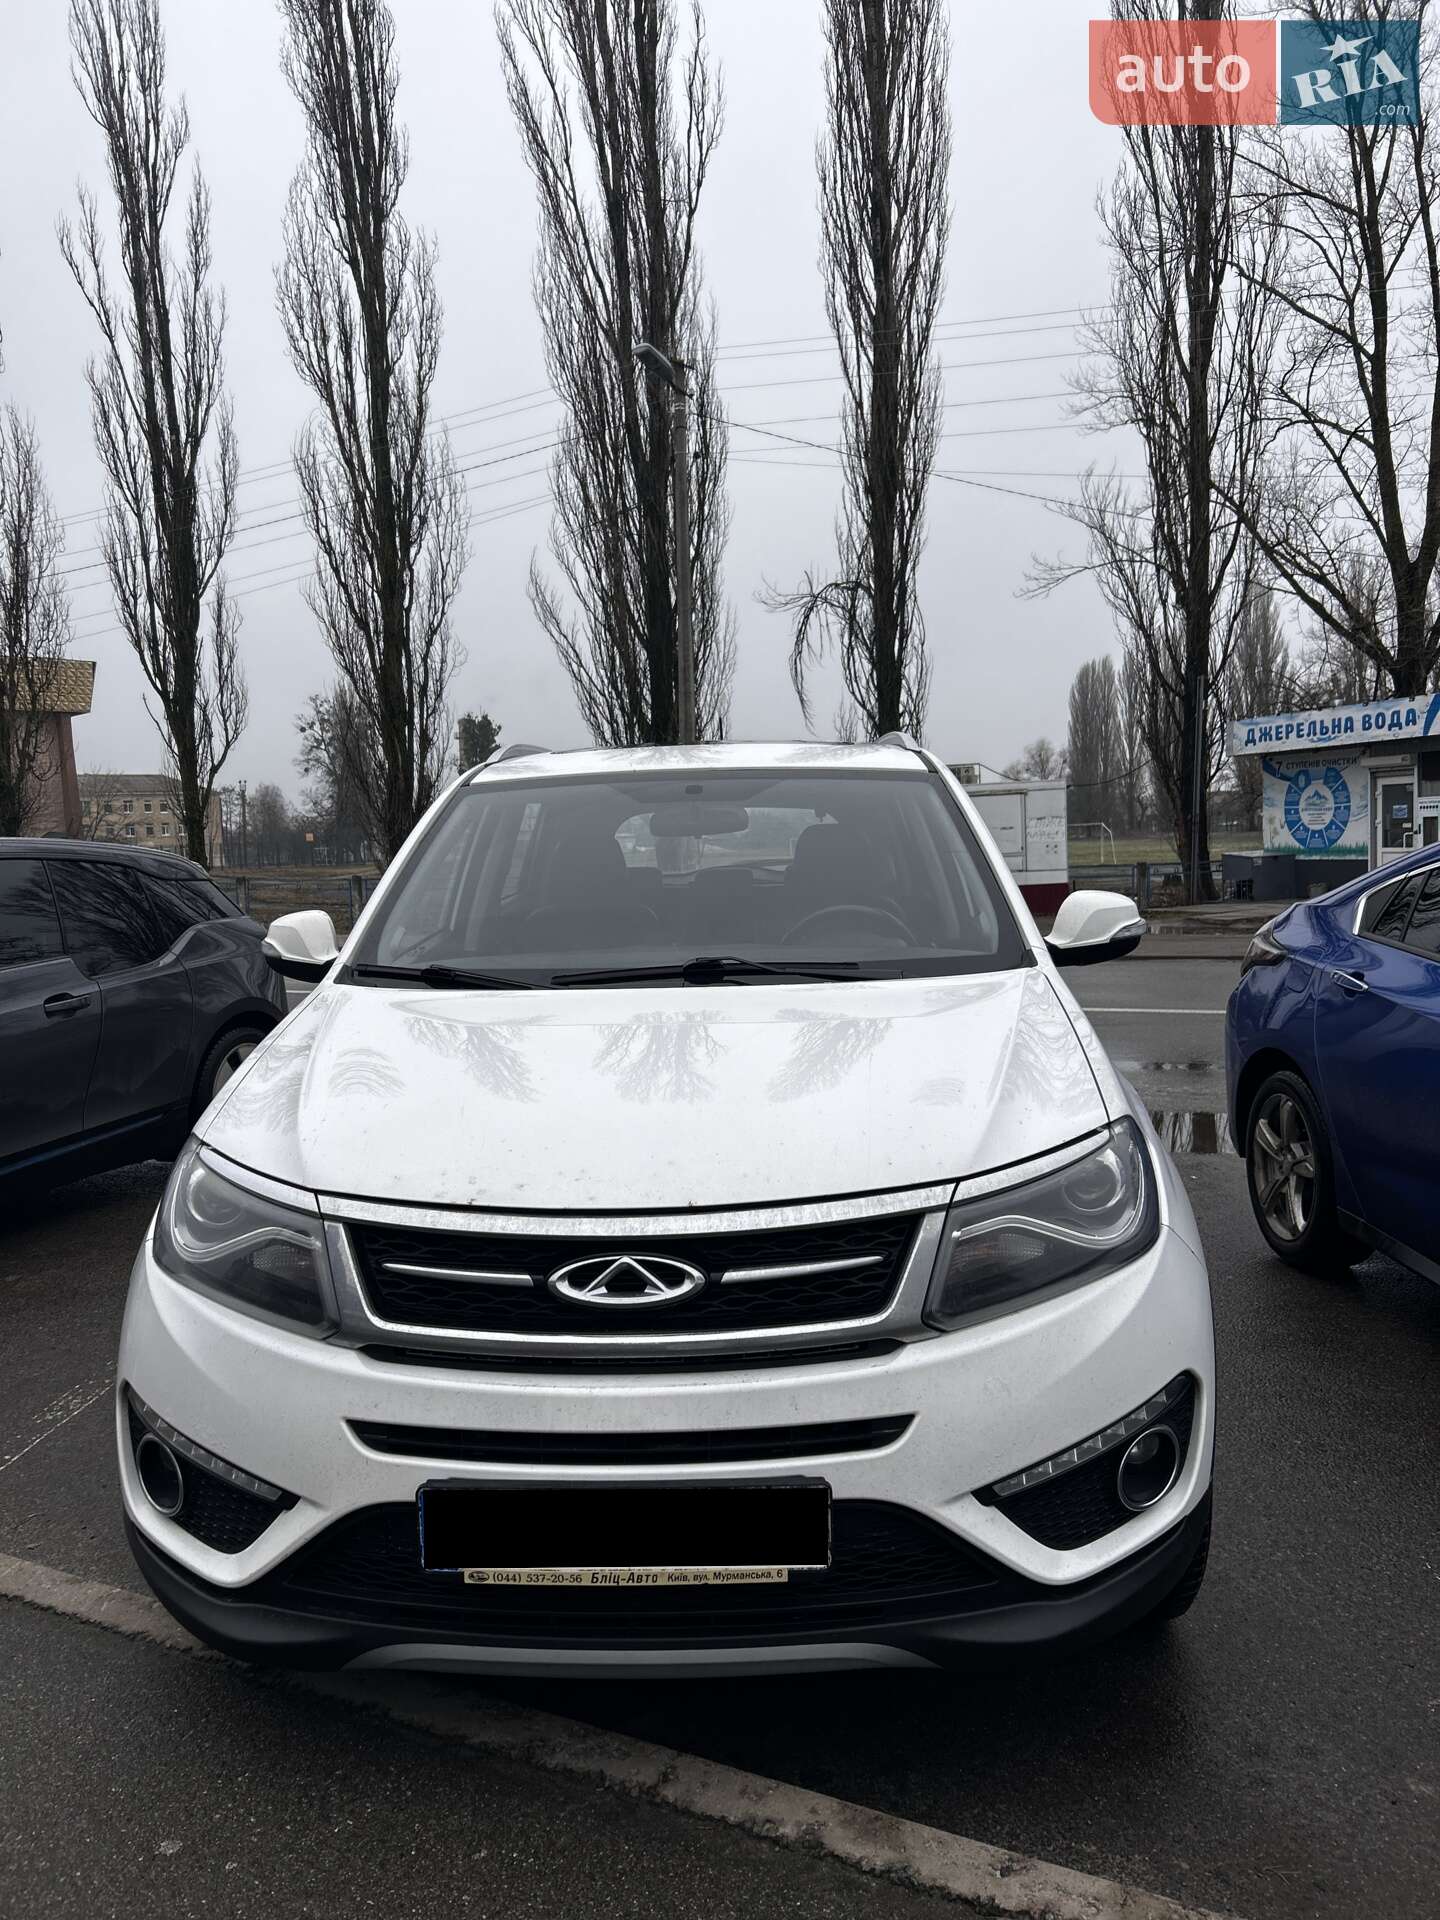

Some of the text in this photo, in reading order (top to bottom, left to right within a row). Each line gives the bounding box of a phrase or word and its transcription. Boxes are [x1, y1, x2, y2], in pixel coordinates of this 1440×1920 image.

[1244, 708, 1417, 747] ДЖЕРЕЛЬНА ВОДА
[492, 1572, 522, 1583] (044)
[526, 1573, 582, 1583] 537-20-56
[590, 1572, 658, 1585] Бліц-Авто
[667, 1572, 690, 1583] Київ,
[713, 1569, 774, 1583] Мурманська,
[776, 1569, 783, 1578] 6
